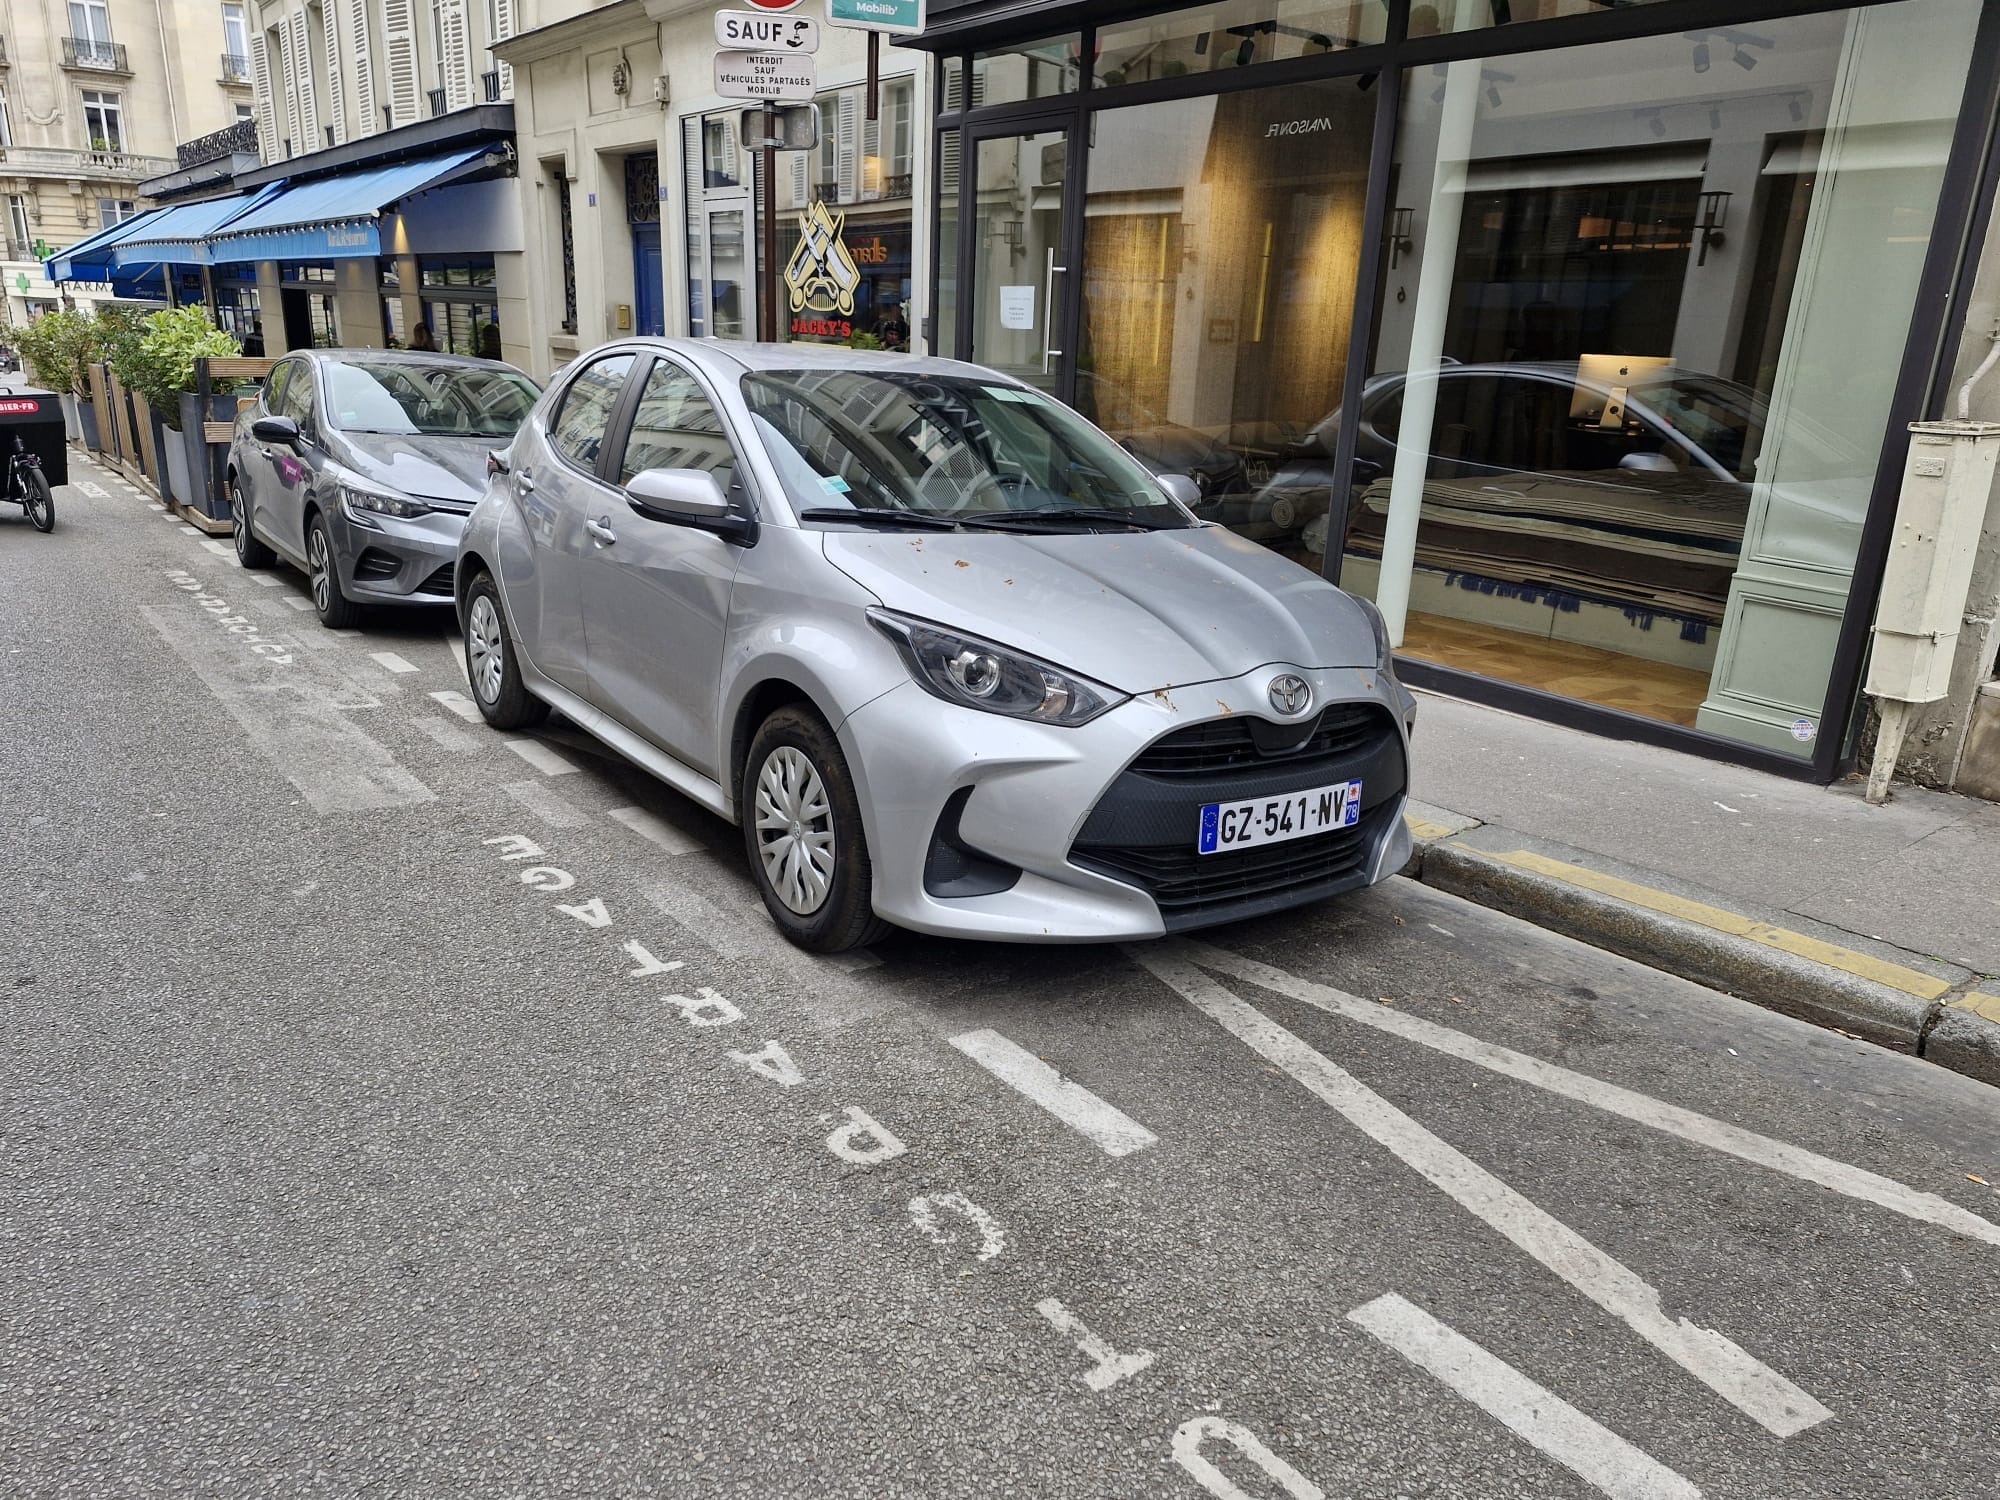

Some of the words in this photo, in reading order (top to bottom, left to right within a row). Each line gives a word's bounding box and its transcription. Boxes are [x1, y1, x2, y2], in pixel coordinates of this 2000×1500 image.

[856, 2, 898, 16] Mobilib'
[726, 19, 783, 42] SAUF
[746, 55, 783, 65] INTERDIT
[754, 66, 776, 75] SAUF
[720, 74, 765, 84] VÉHICULES
[769, 77, 811, 86] PARTAGÉS
[64, 281, 114, 293] HARM
[792, 318, 851, 337] JACKY'S
[1220, 789, 1345, 844] GZ-541-NV
[1346, 804, 1358, 820] 78
[1206, 833, 1213, 843] F
